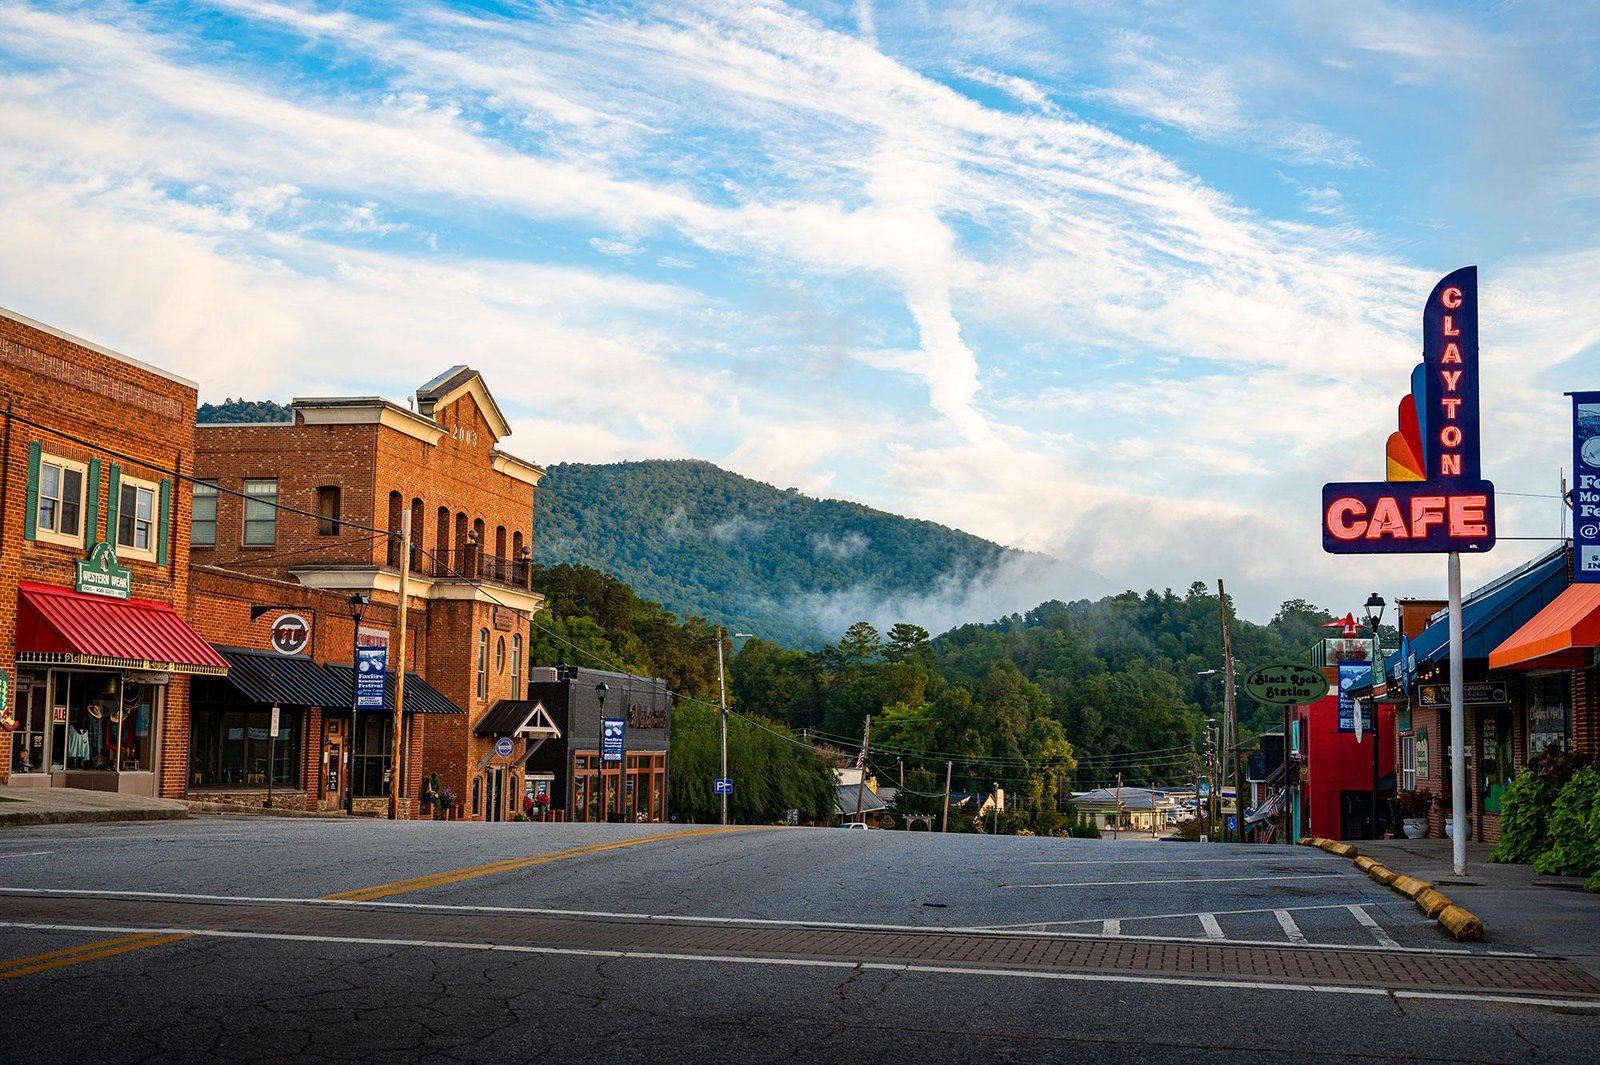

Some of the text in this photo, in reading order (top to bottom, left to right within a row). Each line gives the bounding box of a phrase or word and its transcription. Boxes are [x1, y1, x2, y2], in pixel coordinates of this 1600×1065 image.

[1441, 287, 1462, 476] CLAYTON
[452, 424, 477, 447] 2003
[1327, 496, 1488, 540] CAFE
[83, 571, 127, 588] WESTERN WEAR
[1254, 674, 1318, 686] Black Rock
[1265, 686, 1311, 698] Station
[54, 709, 66, 721] ALE
[717, 782, 724, 791] P
